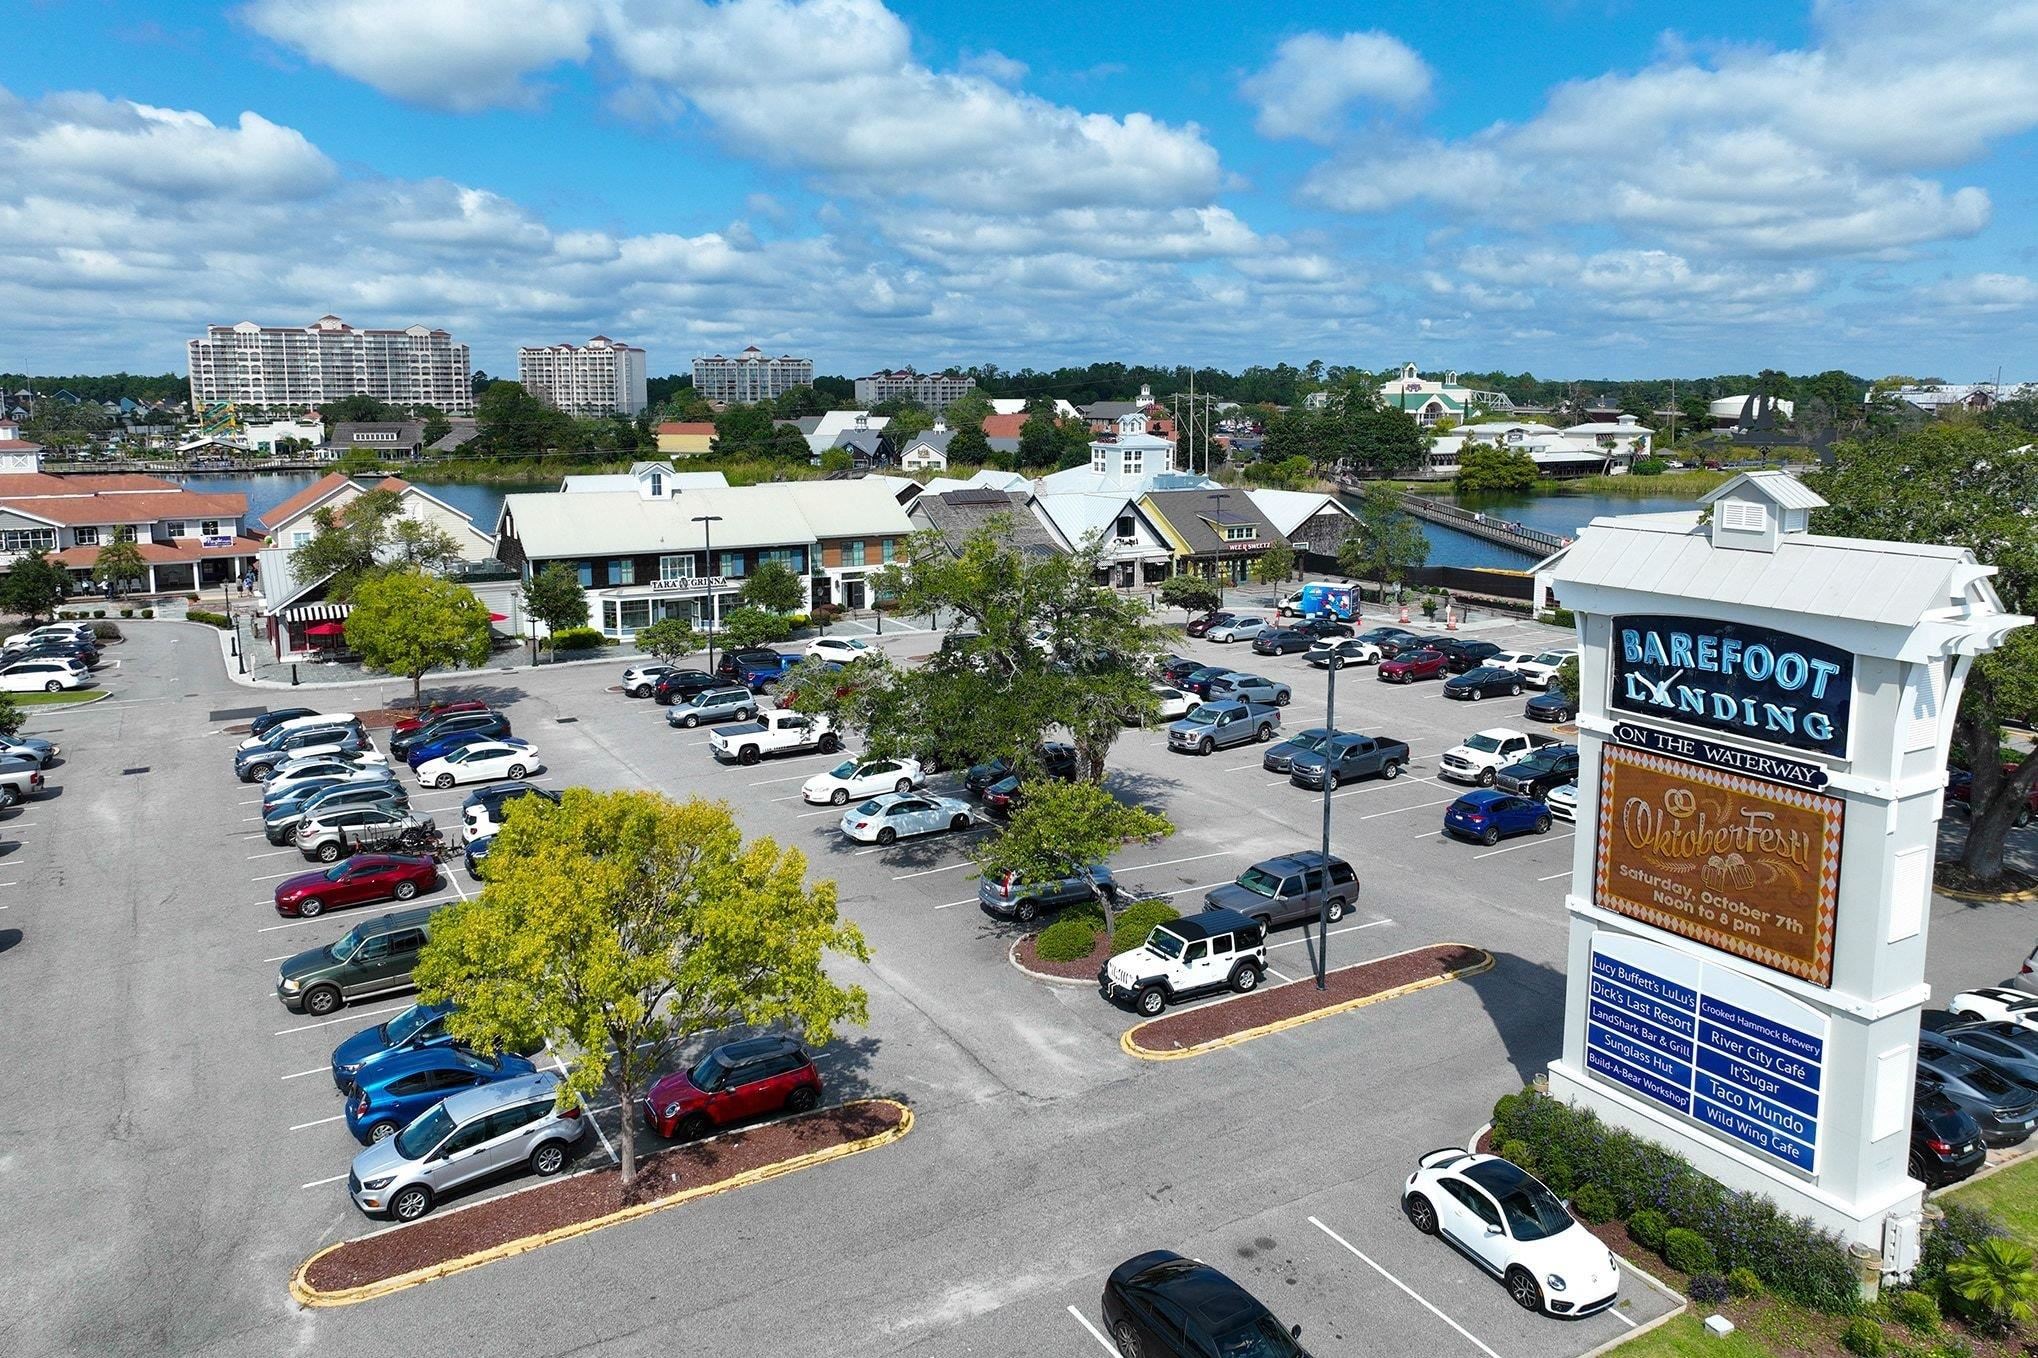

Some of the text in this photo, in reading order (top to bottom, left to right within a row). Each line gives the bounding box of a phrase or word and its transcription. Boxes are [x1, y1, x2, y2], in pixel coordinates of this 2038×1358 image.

[652, 577, 727, 588] TARA GRINNA
[1622, 628, 1840, 700] BAREFOOT
[1624, 670, 1834, 740] LANDING
[1619, 726, 1818, 784] ON THE WATERWAY
[1619, 864, 1804, 935] Saturday, October 7th
[1653, 890, 1761, 937] Noon to 8 pm
[1592, 980, 1692, 1033] Dick's Last Resort
[1594, 957, 1695, 1008] Lucy Buffett's LuLu's
[1592, 1006, 1690, 1058] LandShark Bar & Grill
[1604, 1034, 1673, 1075] Sunglass Hut
[1702, 1002, 1821, 1056] Crooked Hammock Brewery
[1712, 1030, 1806, 1080] River City Café
[1589, 1053, 1642, 1084] Build-A-Bear
[1706, 1106, 1800, 1160] Wild Wing Cafe
[1710, 1079, 1804, 1134] Taco Mundo
